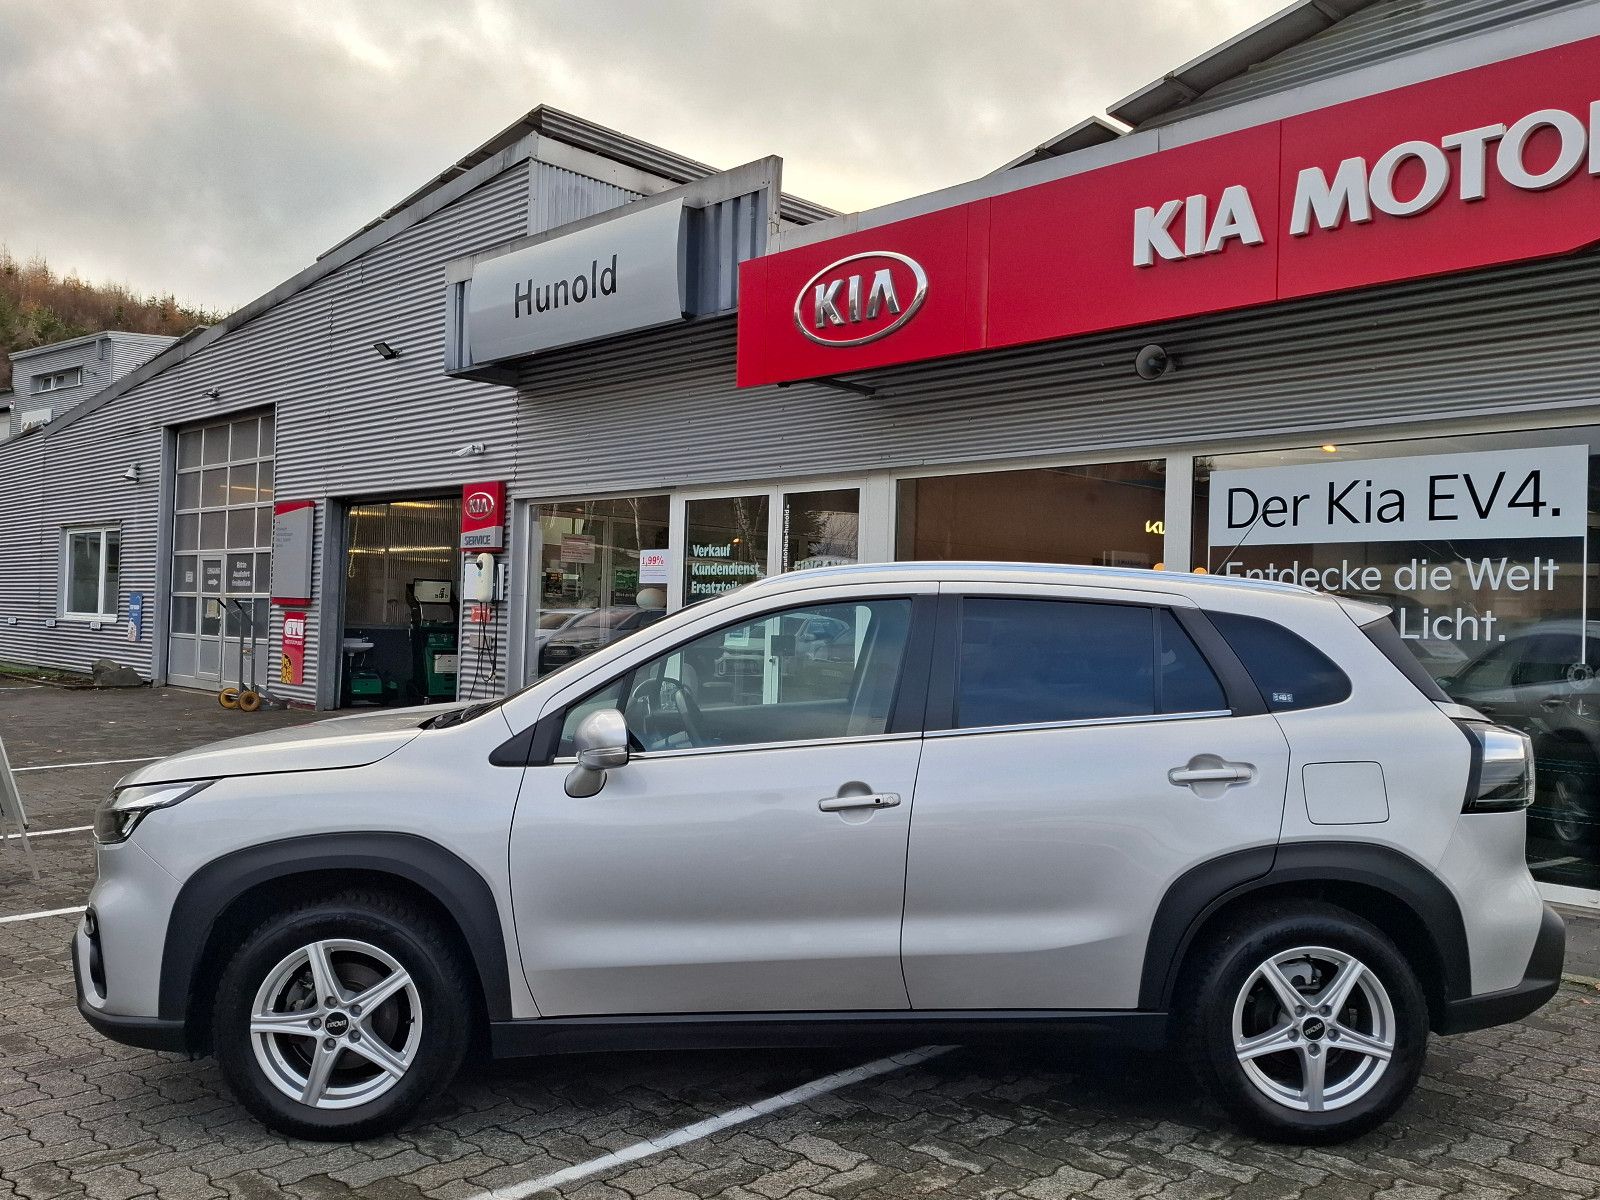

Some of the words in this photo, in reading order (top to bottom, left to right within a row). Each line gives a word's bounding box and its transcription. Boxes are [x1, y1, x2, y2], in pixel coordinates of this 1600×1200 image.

[1133, 184, 1265, 268] KIA
[1289, 99, 1600, 237] MOTO
[514, 253, 618, 319] Hunold
[814, 268, 901, 329] KIA
[469, 498, 489, 513] KIA
[1227, 487, 1310, 529] Der
[1327, 479, 1405, 525] Kia
[1428, 469, 1561, 521] EV4.
[464, 535, 491, 546] SERVICE
[692, 543, 731, 557] Verkauf
[641, 555, 665, 567] 1,99%
[691, 562, 760, 576] Kundendienst
[1394, 558, 1452, 591] die
[1465, 556, 1560, 591] Welt
[690, 581, 742, 594] Ersatzteil
[1400, 608, 1506, 642] Licht.
